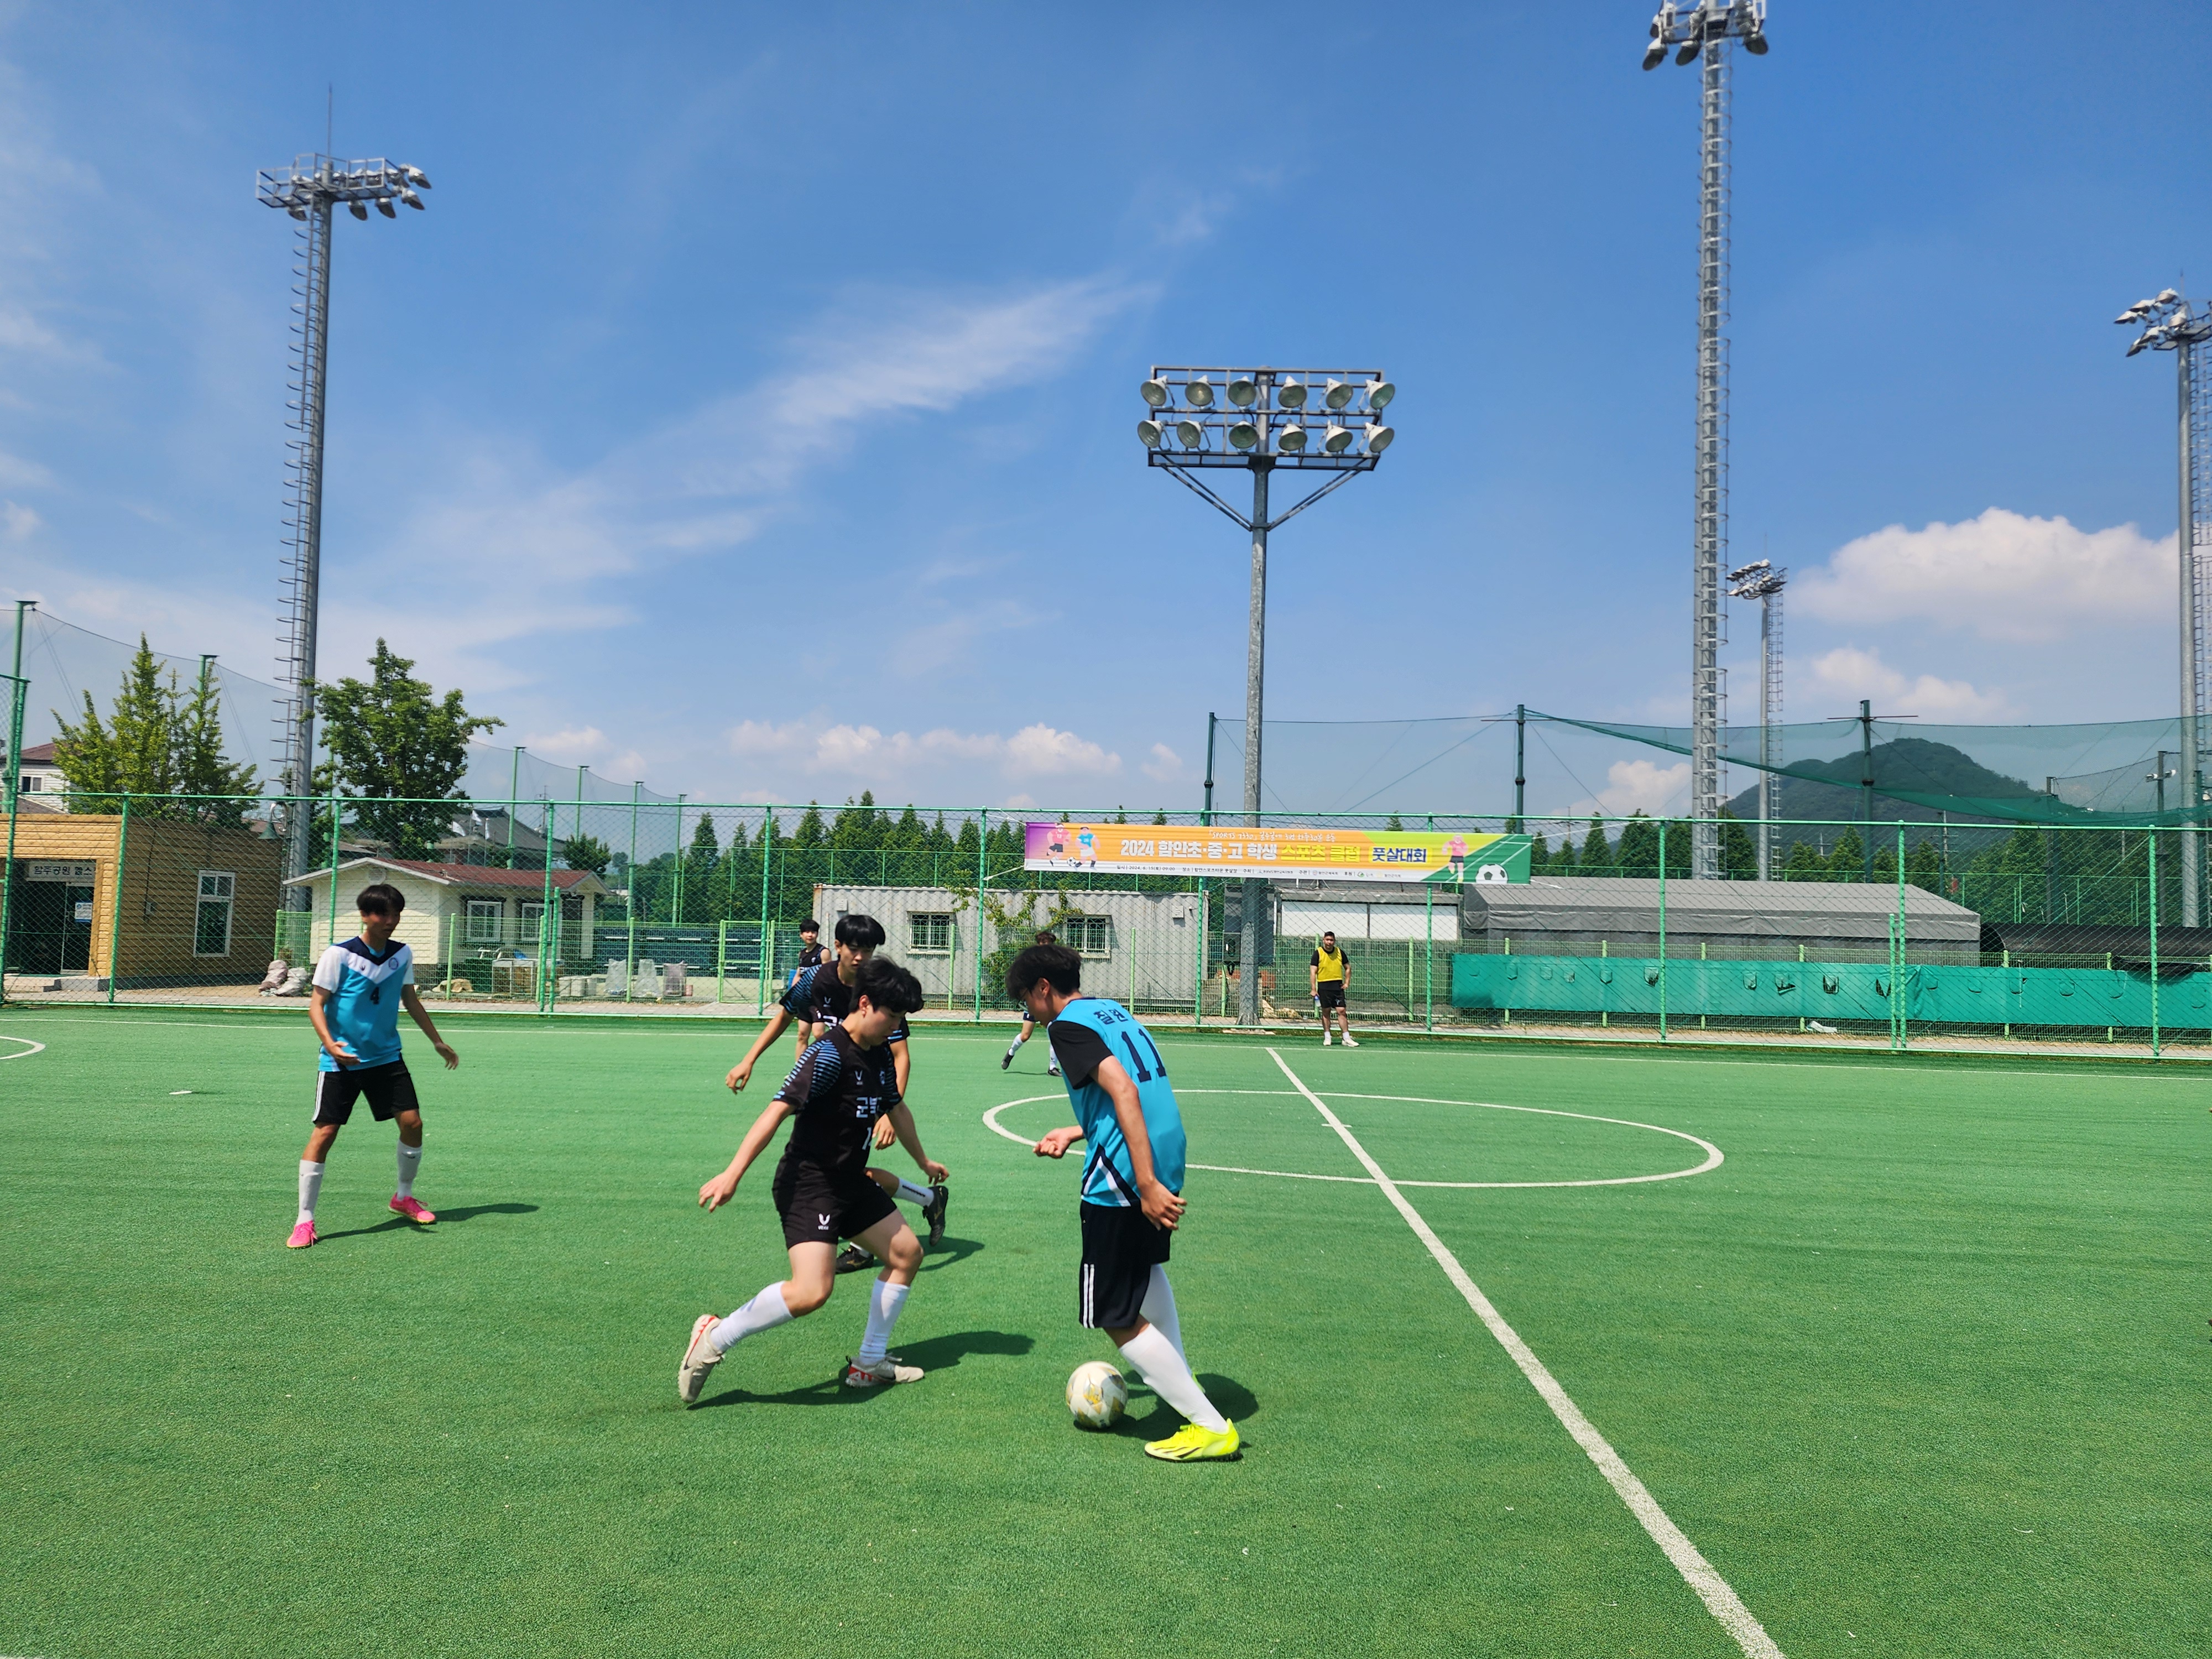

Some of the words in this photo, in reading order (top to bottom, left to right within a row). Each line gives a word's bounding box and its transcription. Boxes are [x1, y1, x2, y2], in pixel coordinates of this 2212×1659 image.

[1120, 839, 1155, 857] 2024
[1247, 843, 1278, 860] 학생
[1280, 844, 1326, 862] 스포츠
[1330, 846, 1361, 863] 클럽
[1372, 847, 1427, 863] 풋살대회
[75, 866, 96, 875] 헬스
[370, 986, 379, 1005] 4
[1121, 1028, 1167, 1083] 11
[856, 1097, 882, 1118] 군북
[862, 1126, 872, 1150] 1
